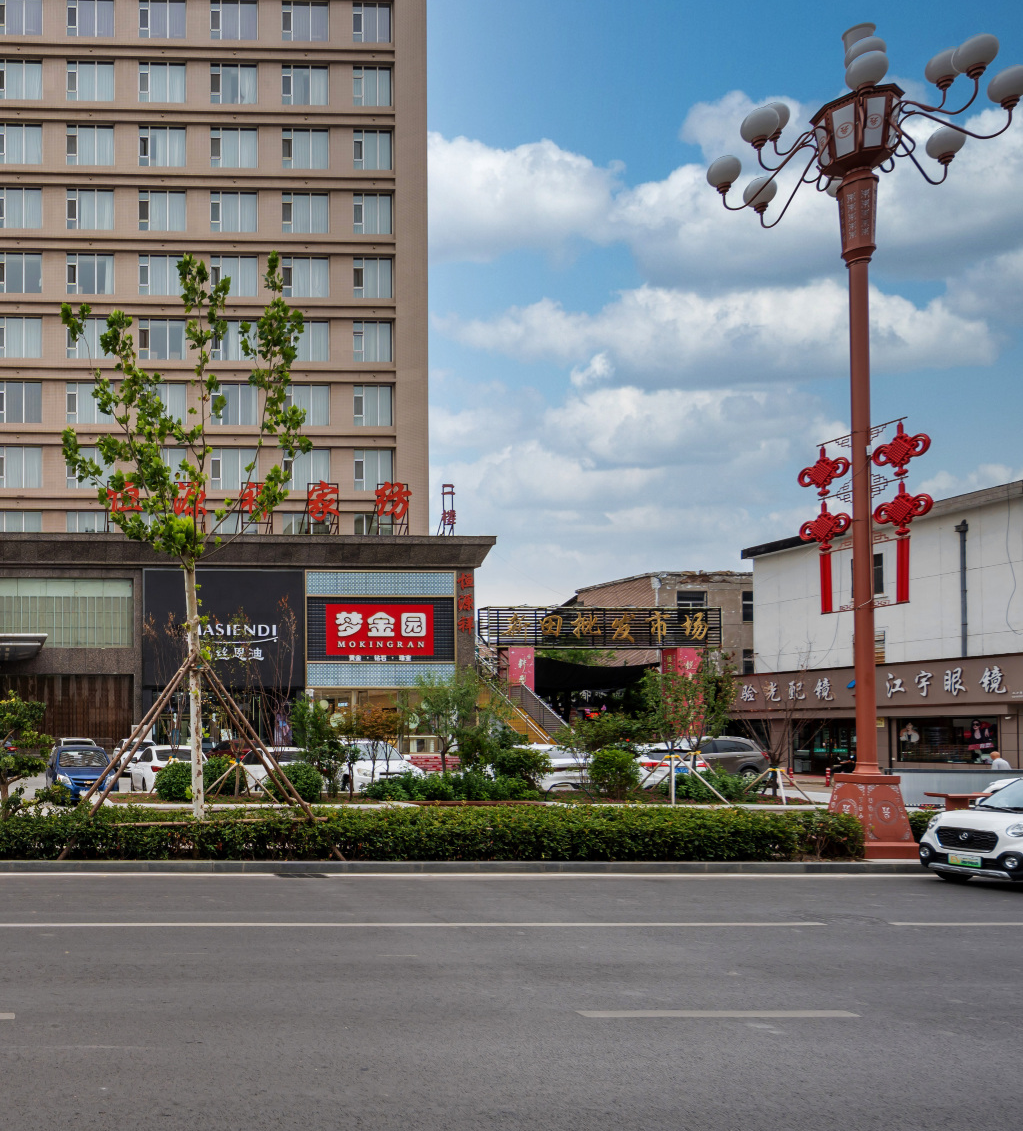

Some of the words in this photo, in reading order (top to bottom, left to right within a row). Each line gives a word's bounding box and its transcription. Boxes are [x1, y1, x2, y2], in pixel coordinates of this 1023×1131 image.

[441, 483, 457, 525] 二楼
[457, 572, 475, 636] 恒源祥
[335, 611, 427, 637] 梦金园
[337, 641, 425, 649] MOKINGRAN
[740, 677, 834, 702] 验光配镜
[885, 666, 1007, 698] 江宇眼镜
